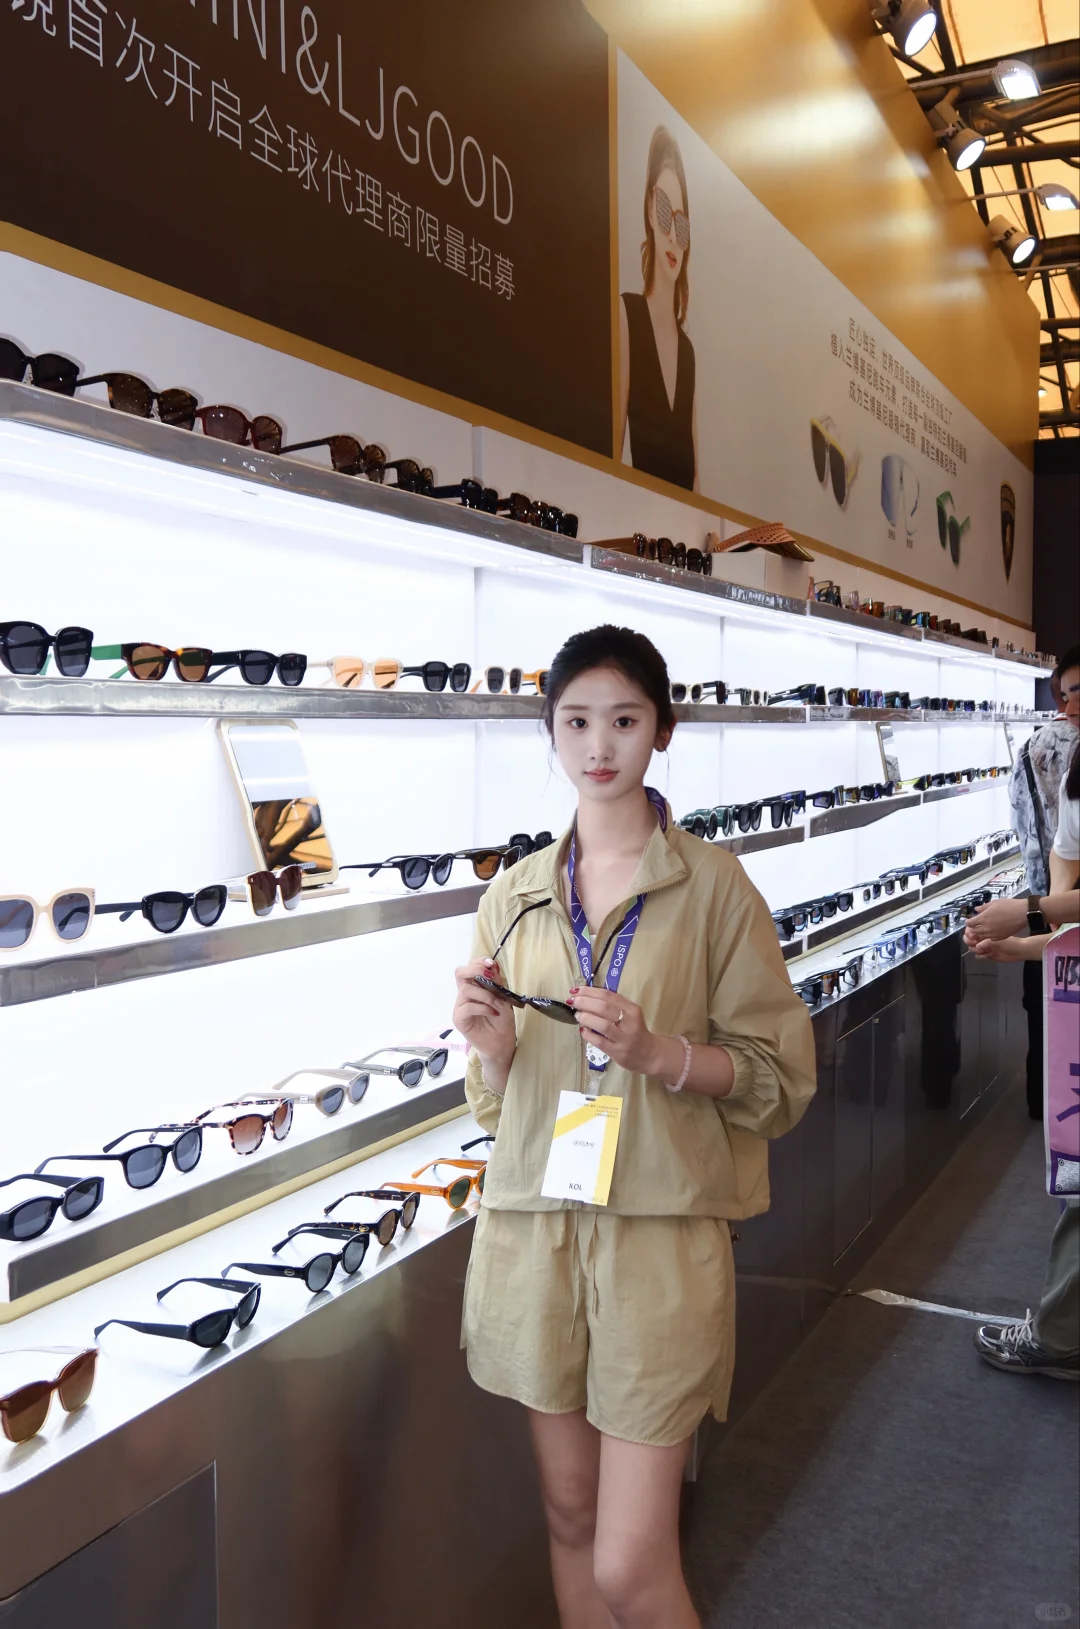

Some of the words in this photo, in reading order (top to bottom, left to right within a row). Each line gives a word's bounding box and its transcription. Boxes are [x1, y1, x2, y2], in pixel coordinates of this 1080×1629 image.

[190, 0, 514, 225] NI&LJGOOD
[614, 944, 627, 967] ISPO
[569, 1182, 582, 1191] KOL
